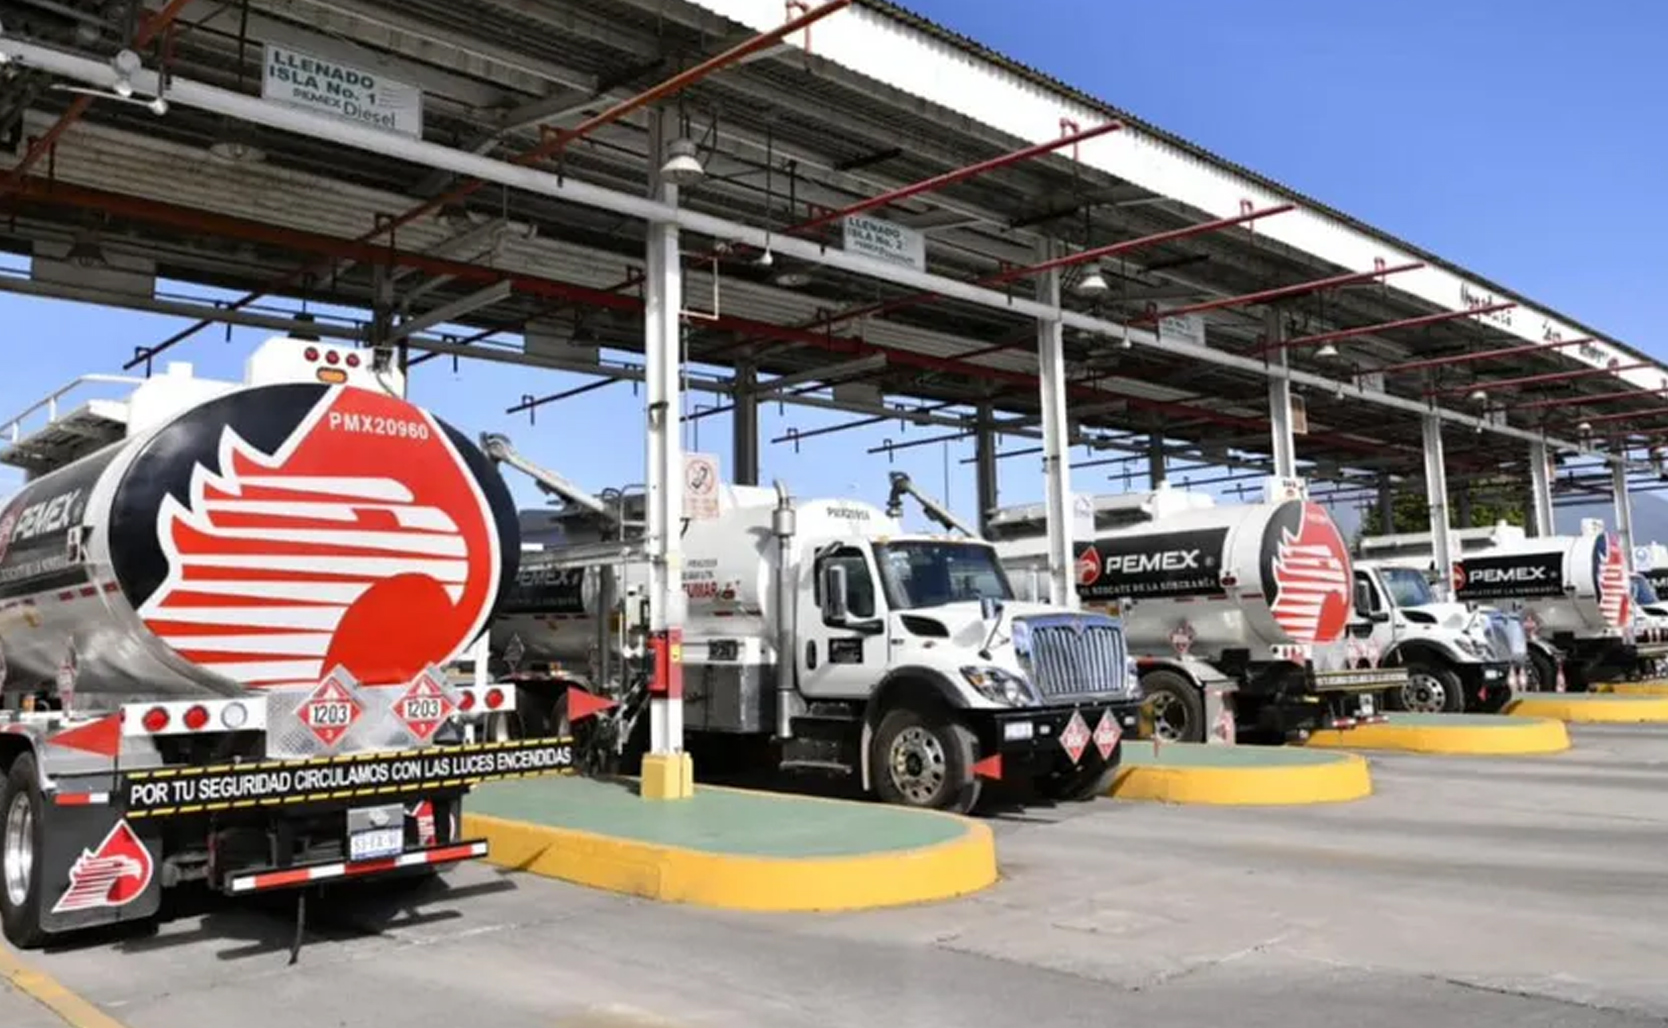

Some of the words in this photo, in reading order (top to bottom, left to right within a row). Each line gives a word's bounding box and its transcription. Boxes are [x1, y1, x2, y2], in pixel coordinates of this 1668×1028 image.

[274, 50, 375, 89] LLENADO
[269, 64, 319, 90] ISLA
[326, 81, 360, 101] No.
[365, 92, 377, 105] 1
[343, 100, 396, 128] Diesel
[328, 411, 429, 440] PMX20960
[1105, 550, 1200, 575] PEMEX
[1469, 566, 1547, 583] PEMEX
[313, 704, 348, 724] 1203
[407, 700, 439, 718] 1203
[130, 782, 168, 805] POR
[173, 780, 196, 801] TU
[199, 772, 291, 799] SEGURIDAD
[294, 763, 389, 789] CIRCULAMOS
[391, 760, 422, 779] CON
[424, 758, 450, 778] LAS
[453, 754, 495, 774] LUCES
[497, 747, 572, 770] ENCENDIDAS
